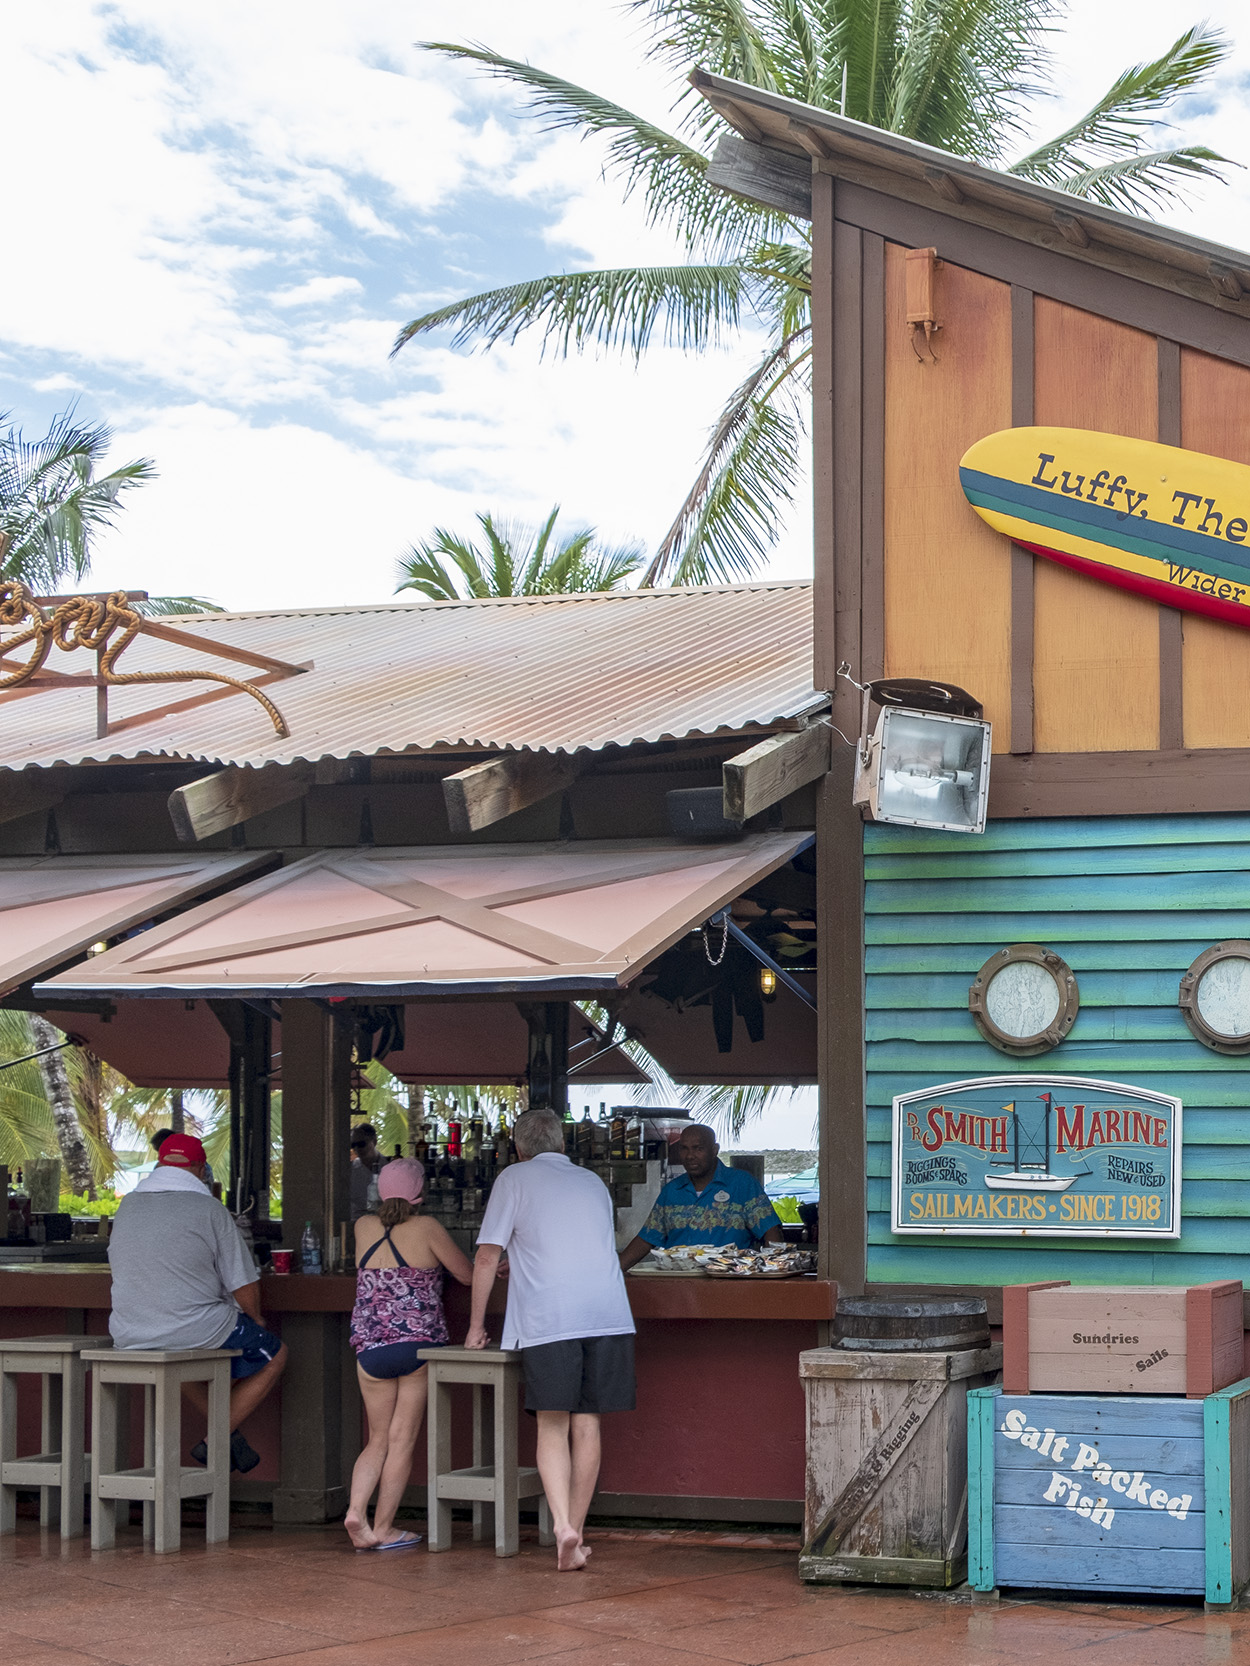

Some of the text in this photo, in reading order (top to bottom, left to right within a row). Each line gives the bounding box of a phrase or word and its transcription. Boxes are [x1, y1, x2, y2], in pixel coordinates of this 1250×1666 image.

[1031, 453, 1148, 521] Luffy,
[1172, 490, 1248, 542] The
[1167, 561, 1246, 603] Wider
[921, 1105, 1009, 1154] SMITH
[1054, 1105, 1168, 1154] MARINE
[905, 1170, 935, 1185] BOOMS
[939, 1169, 967, 1186] SPARS
[907, 1156, 956, 1173] RIGGINGS
[1107, 1155, 1154, 1175] REPAIRS
[1107, 1168, 1133, 1183] NEW
[1140, 1173, 1166, 1187] USED
[909, 1193, 1161, 1221] SAILMAKERS SINCE 1918
[1072, 1333, 1140, 1344] Sundries
[1135, 1348, 1169, 1373] Sails
[880, 1411, 920, 1461] Rigging
[1001, 1409, 1192, 1520] Salt Packed
[1043, 1471, 1115, 1530] Fish
